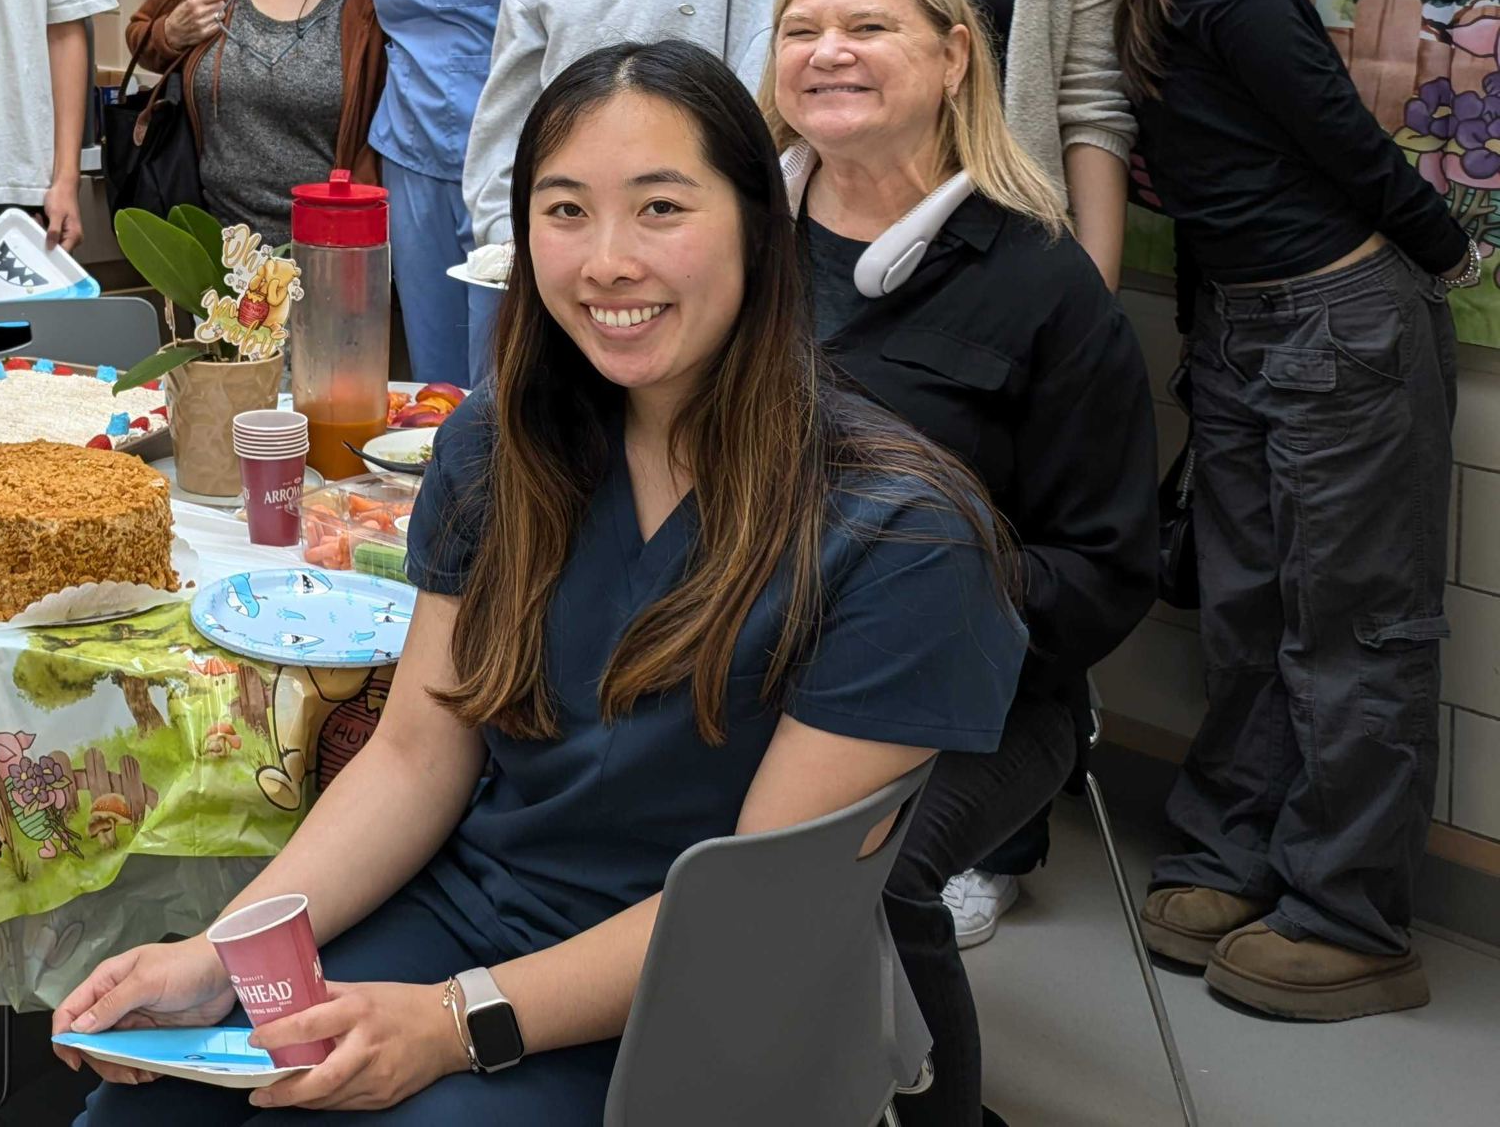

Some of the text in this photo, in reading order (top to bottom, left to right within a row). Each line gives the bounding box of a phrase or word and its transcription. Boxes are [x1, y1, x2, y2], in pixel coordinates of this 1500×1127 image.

[224, 224, 261, 273] Oh
[333, 723, 369, 747] HUN
[232, 981, 293, 1004] WHEAD
